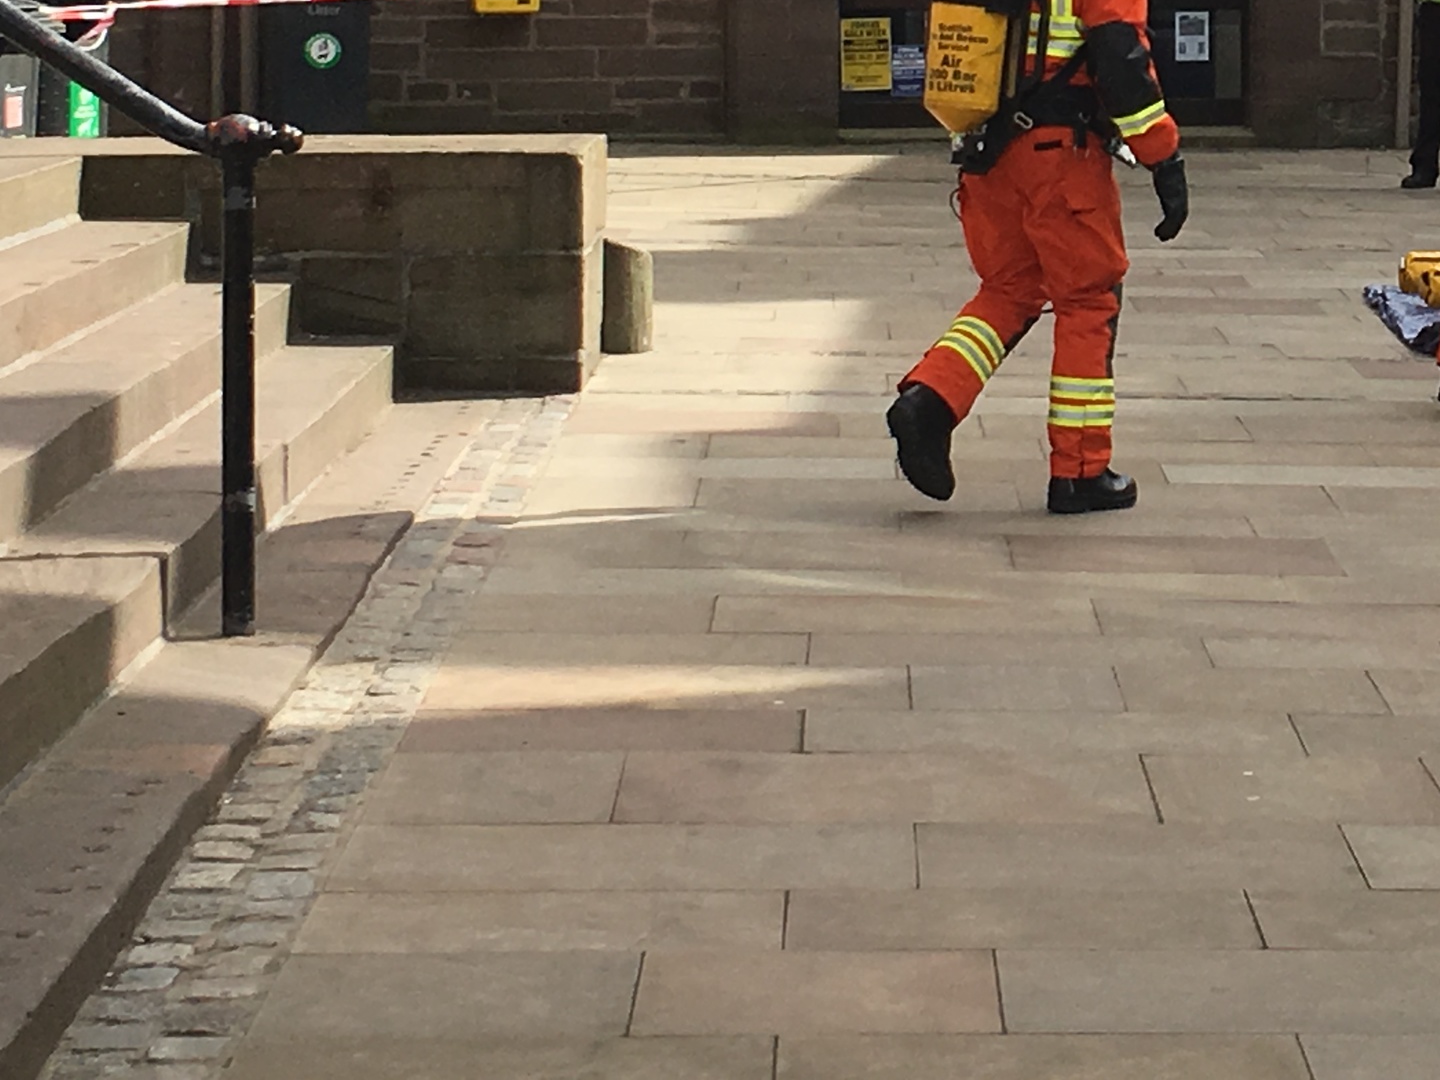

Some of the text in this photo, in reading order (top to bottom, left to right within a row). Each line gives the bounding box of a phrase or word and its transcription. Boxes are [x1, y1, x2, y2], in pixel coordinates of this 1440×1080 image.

[941, 54, 962, 68] Air
[952, 69, 977, 82] Bar
[937, 80, 976, 93] Litres
